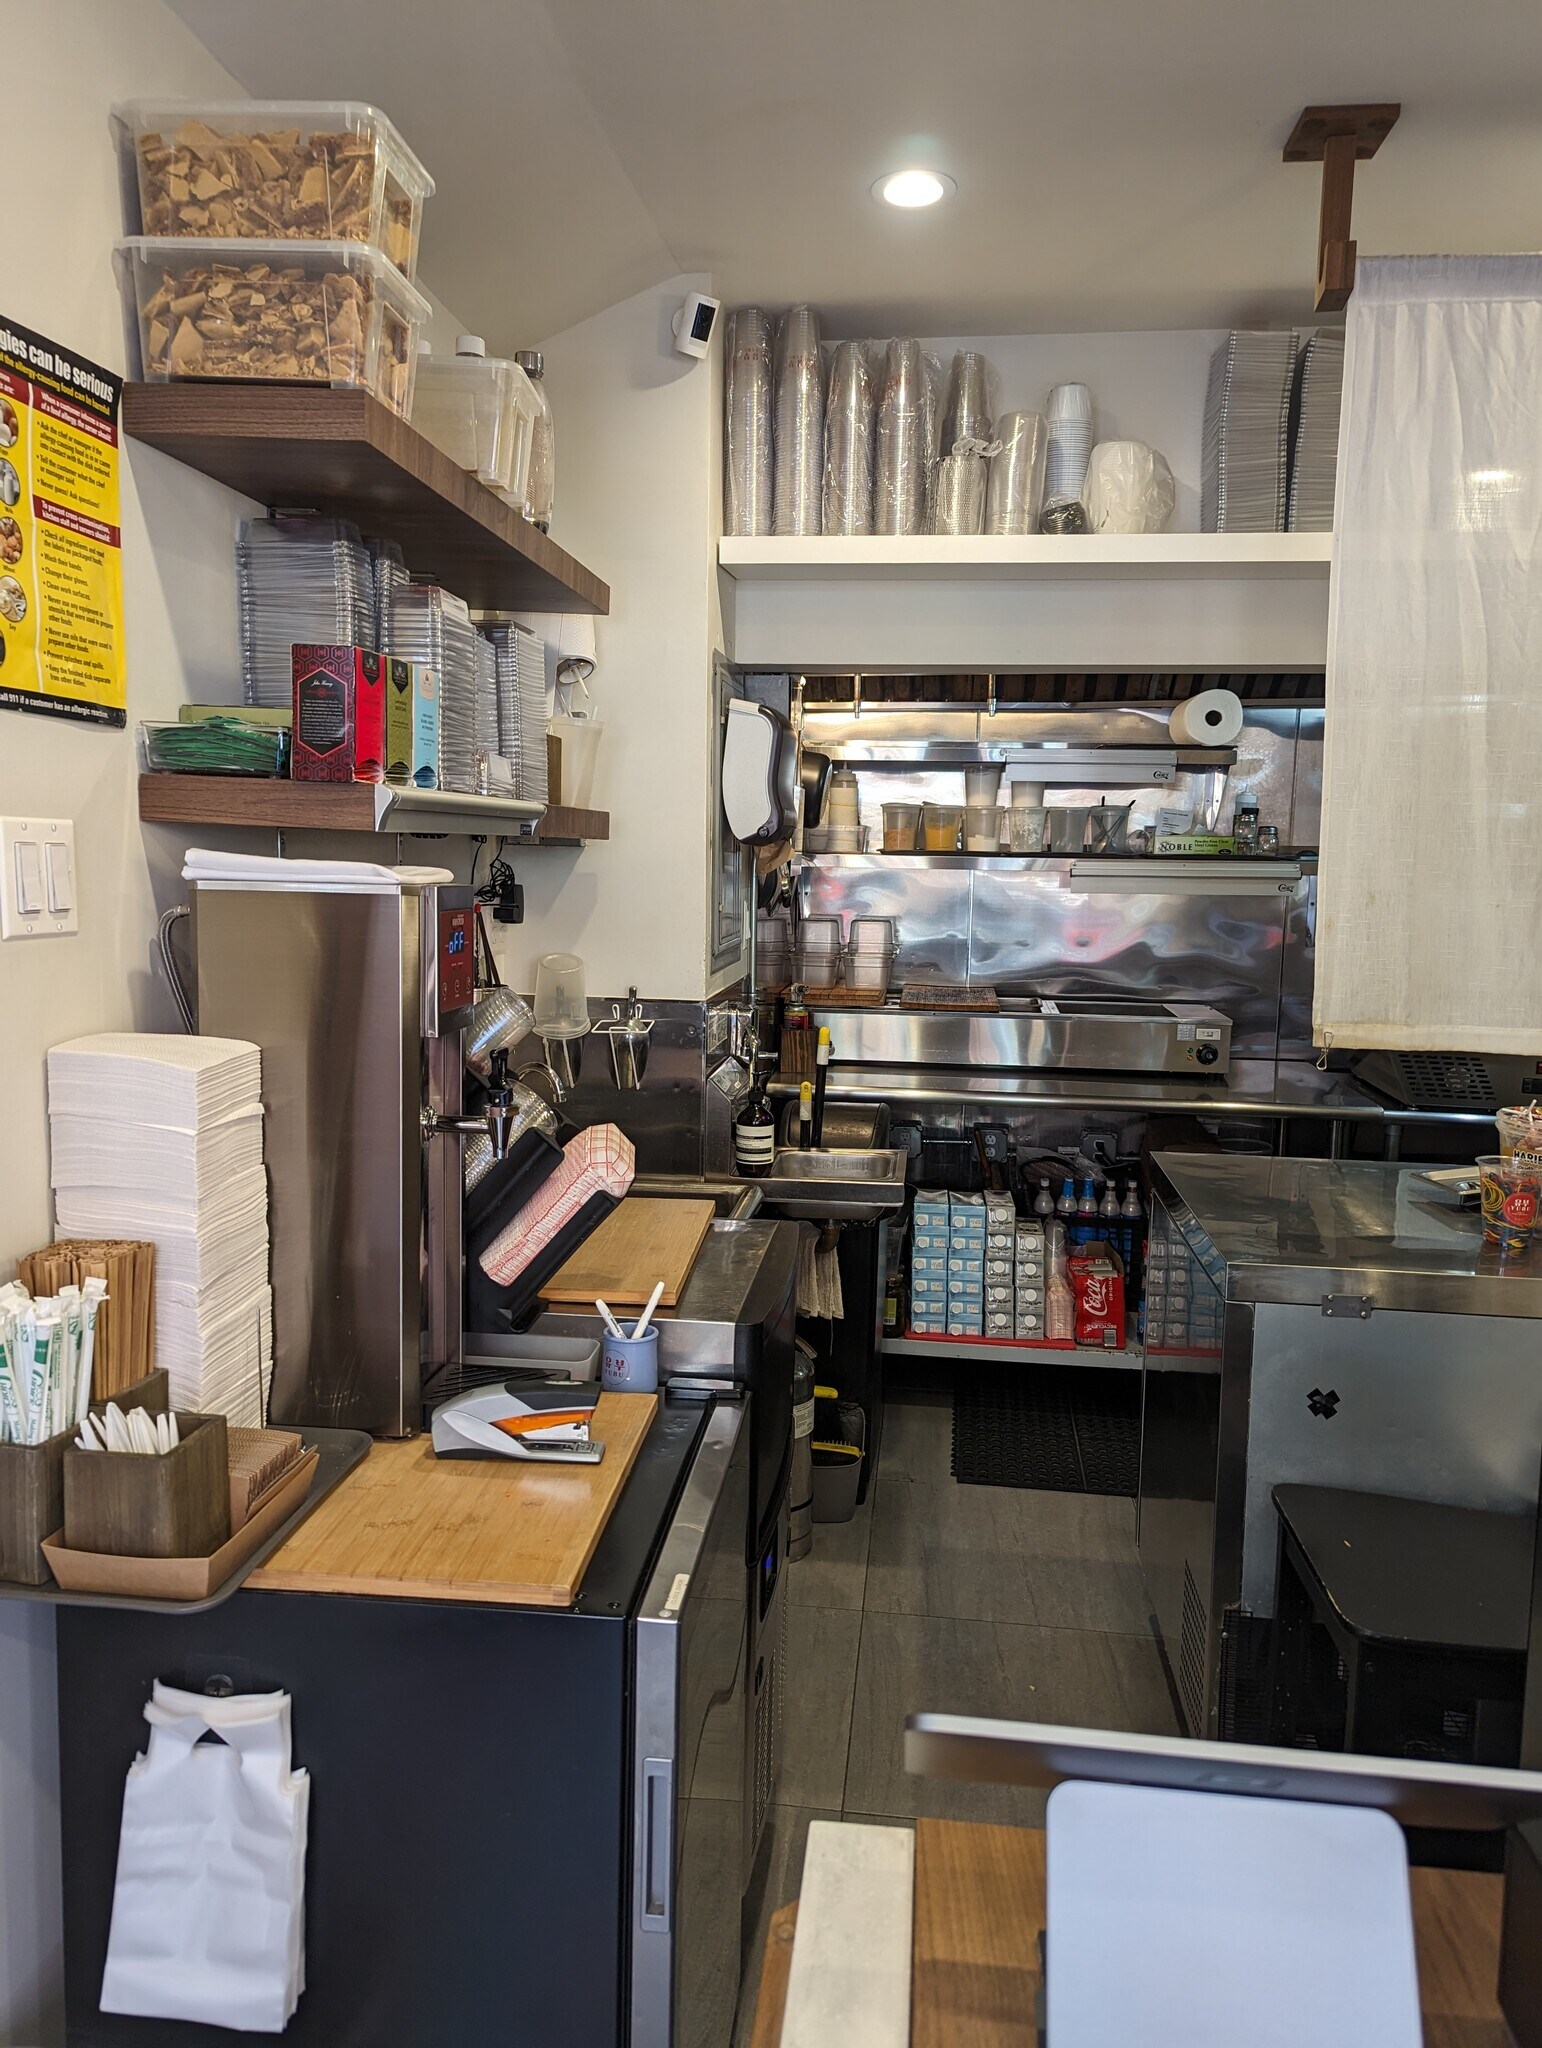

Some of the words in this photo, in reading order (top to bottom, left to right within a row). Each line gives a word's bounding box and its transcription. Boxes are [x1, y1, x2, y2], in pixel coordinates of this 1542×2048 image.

[15, 360, 60, 392] allergy-causing
[61, 382, 74, 396] food
[75, 390, 85, 402] can
[29, 345, 53, 372] can
[55, 354, 71, 380] be
[72, 367, 114, 402] serious
[41, 391, 55, 405] When
[60, 402, 81, 417] customer
[50, 405, 61, 418] food
[41, 432, 74, 454] allergy-causing
[75, 447, 84, 457] food
[100, 460, 110, 469] came
[58, 430, 68, 440] chef
[74, 439, 91, 451] manager
[50, 446, 66, 459] contact
[67, 454, 76, 463] with
[40, 454, 49, 464] Tell
[57, 464, 77, 476] customer
[78, 473, 88, 482] what
[46, 468, 64, 481] manager
[40, 478, 54, 490] Never
[55, 486, 69, 496] guess!
[79, 496, 100, 509] questions!
[48, 504, 66, 516] prevent
[60, 517, 70, 527] staff
[79, 525, 95, 537] servers
[45, 529, 58, 540] Check
[65, 538, 89, 552] ingredients
[96, 550, 105, 559] read
[52, 541, 66, 553] labels
[72, 550, 92, 562] packaged
[44, 553, 57, 564] Wash
[58, 558, 68, 567] their
[69, 561, 83, 572] hands.
[45, 566, 62, 579] Change
[63, 572, 73, 582] their
[74, 577, 89, 587] gloves.
[46, 580, 60, 591] Clean
[60, 586, 72, 595] work
[72, 590, 91, 601] surfaces.
[48, 594, 61, 605] Never
[79, 606, 99, 616] equipment
[48, 605, 66, 616] utensils
[86, 616, 96, 625] used
[100, 621, 114, 631] prepare
[48, 614, 60, 623] other
[48, 626, 62, 637] Never
[70, 633, 79, 642] oils
[79, 635, 88, 644] that
[98, 641, 109, 650] used
[48, 637, 65, 648] prepare
[65, 642, 77, 651] other
[76, 643, 90, 654] foods.
[47, 649, 64, 661] Prevent
[64, 655, 83, 666] splashes
[91, 661, 105, 671] spills.
[49, 663, 60, 675] Keep
[84, 671, 93, 681] dish
[93, 675, 112, 686] separate
[50, 672, 60, 682] from
[60, 676, 72, 685] other
[9, 693, 19, 703] 911
[30, 698, 54, 709] customer
[54, 700, 64, 711] has
[71, 704, 91, 717] allergic
[1159, 842, 1193, 852] NOBLE
[1082, 1277, 1108, 1316] Coca
[604, 1356, 625, 1371] 유부
[604, 1369, 624, 1378] YUBU
